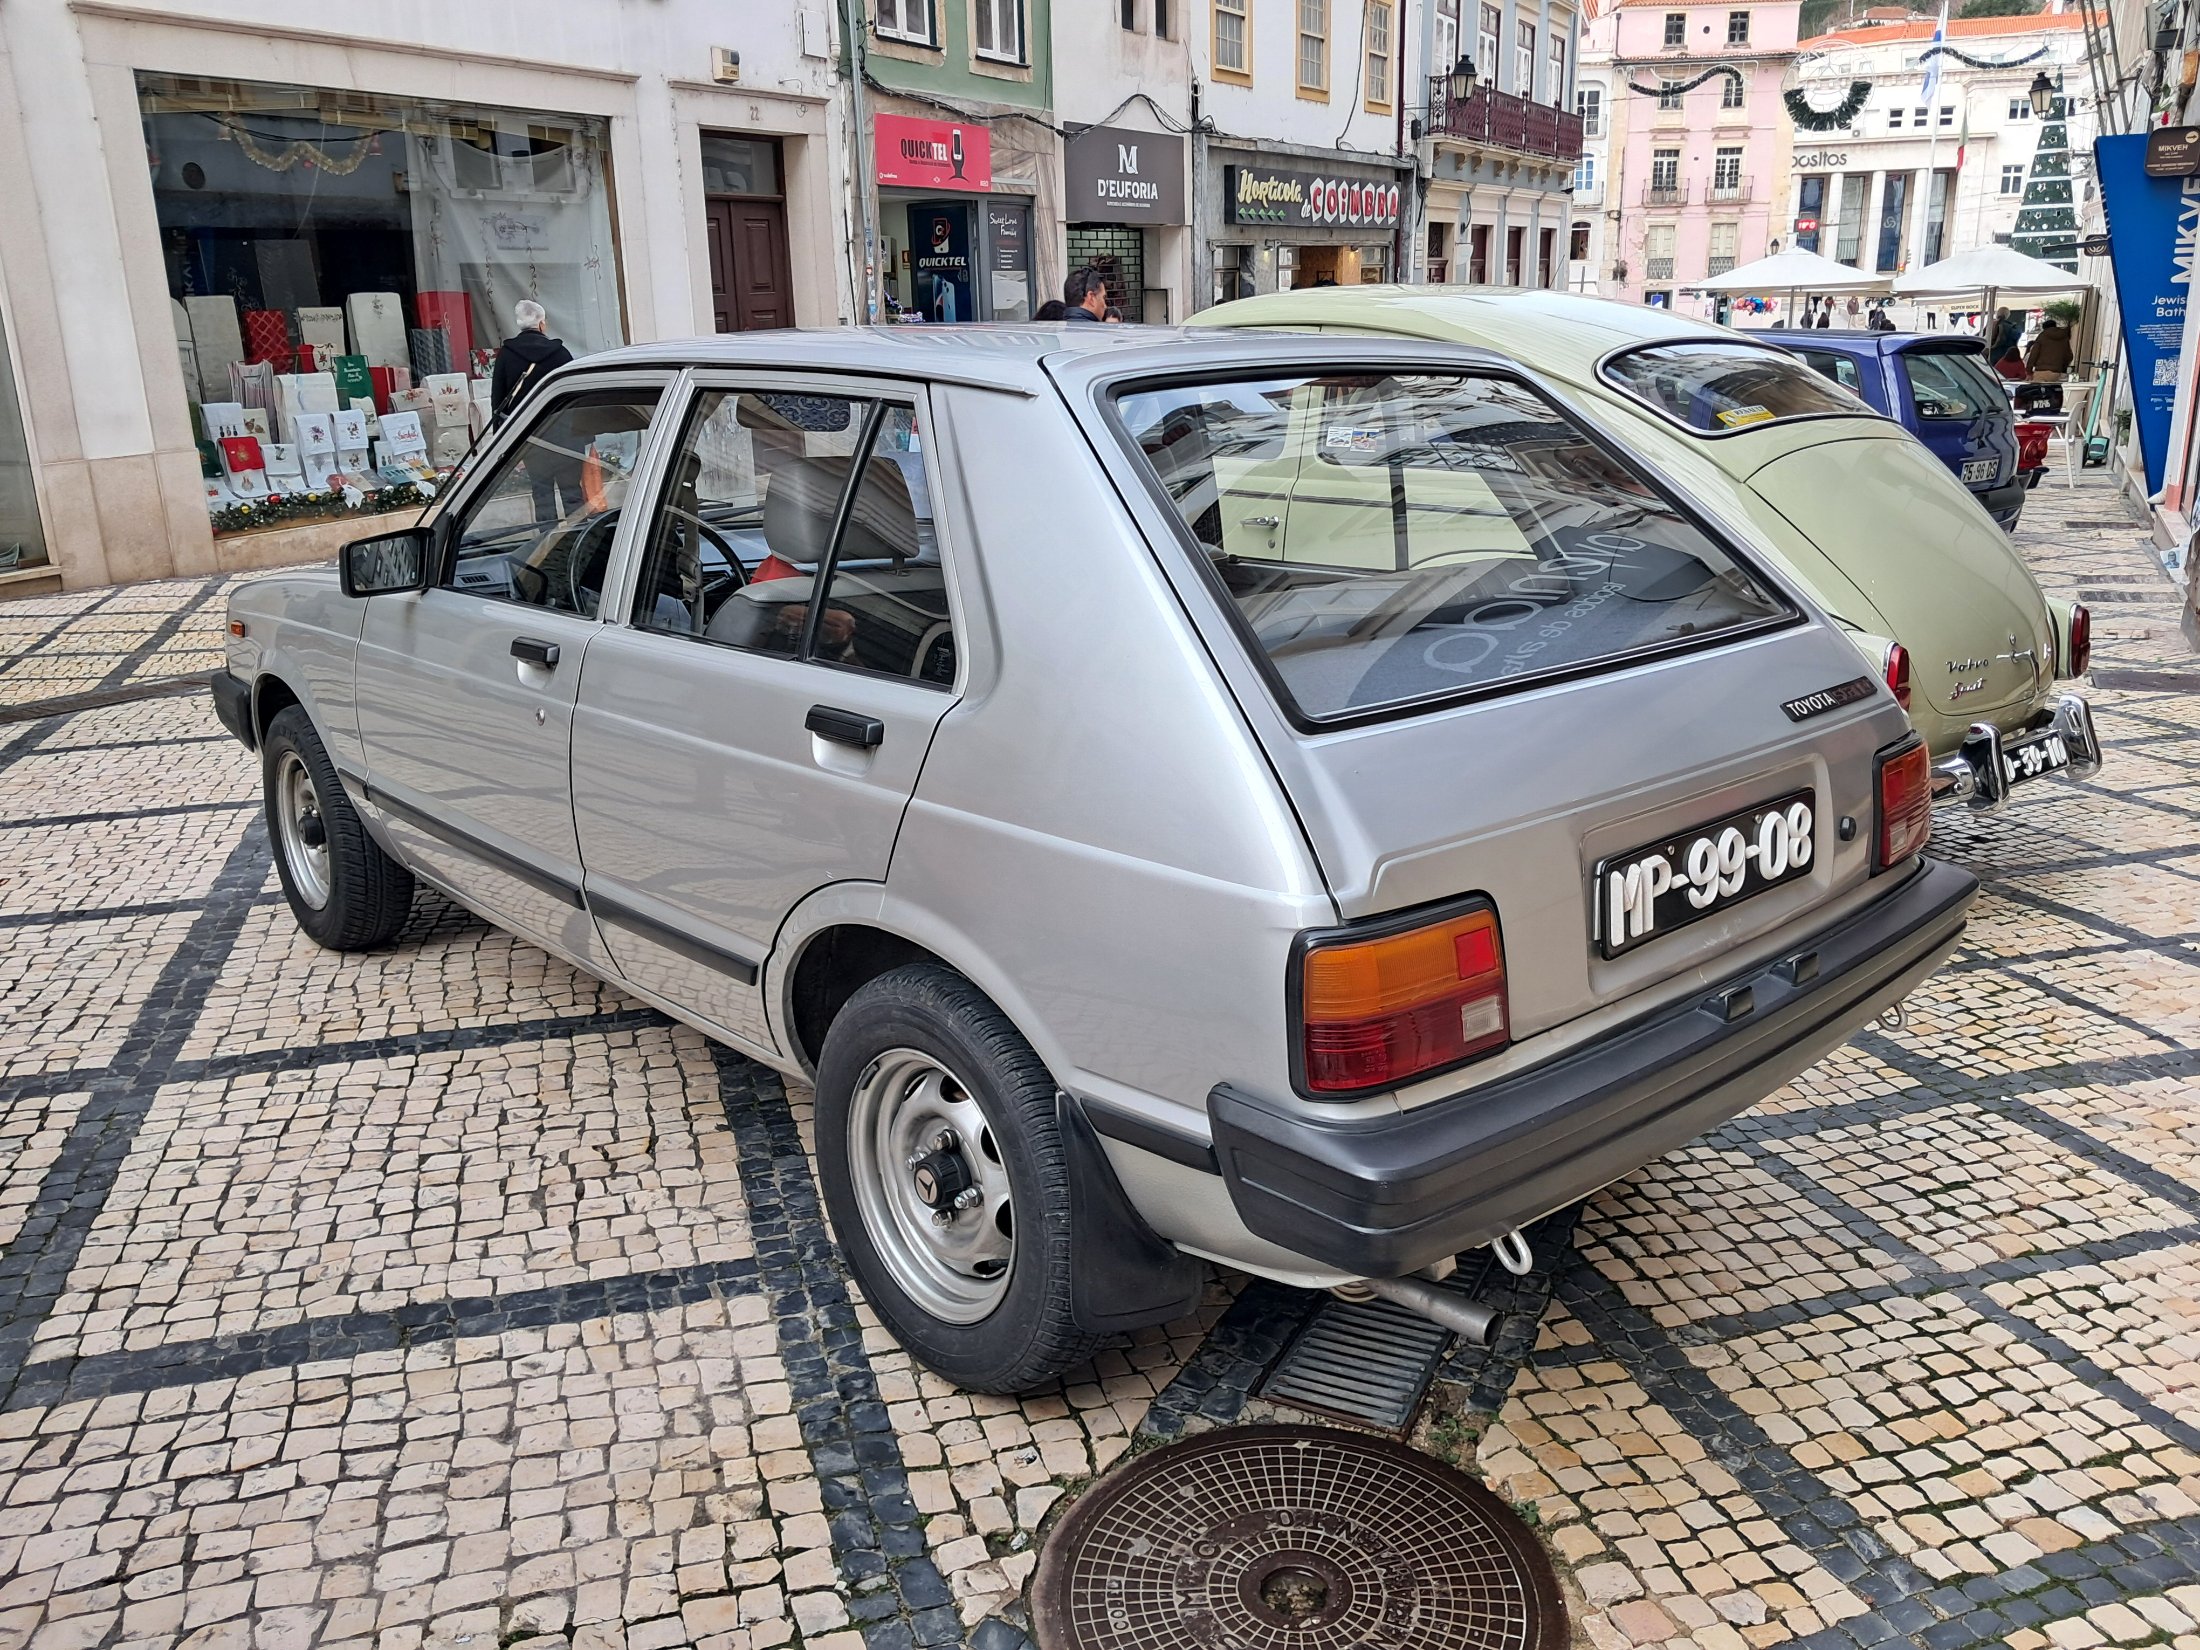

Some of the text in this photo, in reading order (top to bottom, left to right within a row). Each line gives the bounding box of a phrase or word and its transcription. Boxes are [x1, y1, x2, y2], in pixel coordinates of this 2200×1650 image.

[900, 138, 948, 161] QUICKTEL
[2158, 143, 2189, 152] MIKVEH
[1097, 178, 1159, 200] D'EUFORIA
[2169, 176, 2200, 284] MIKVE
[919, 256, 967, 268] QUICKTEL
[2151, 294, 2187, 306] Jewis
[2155, 306, 2187, 318] Bath
[1945, 657, 1990, 674] Volvo
[1785, 692, 1837, 718] TOYOTA
[1609, 801, 1814, 948] MP-99-08
